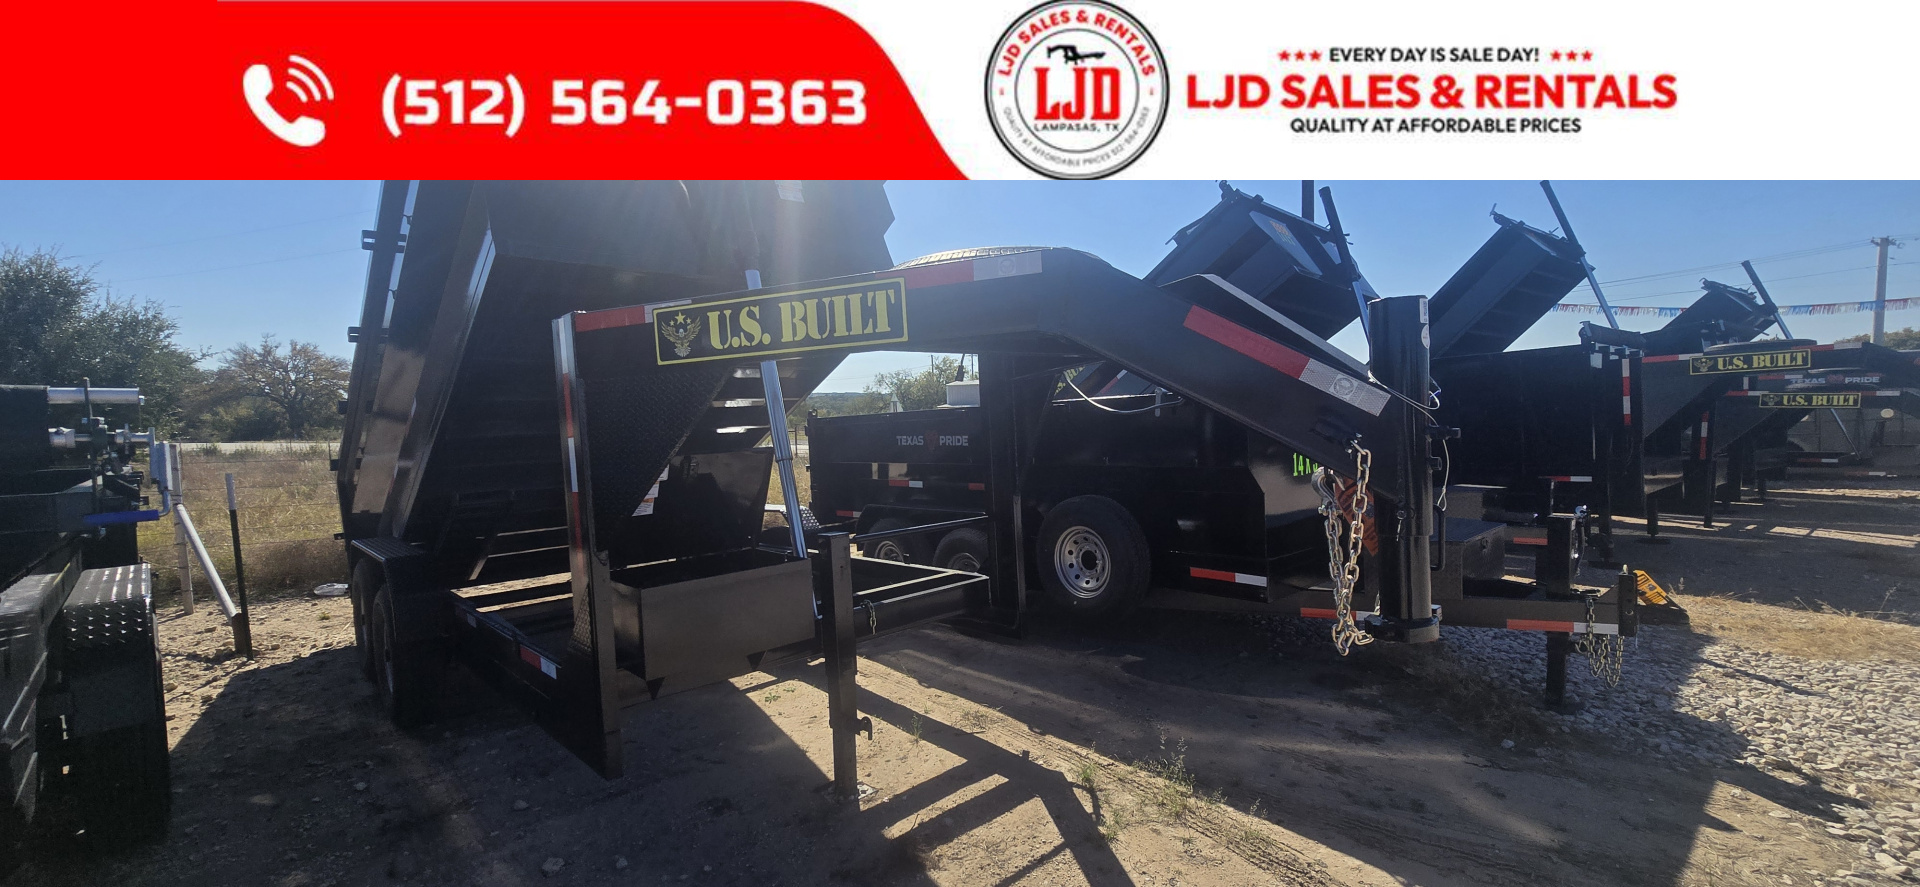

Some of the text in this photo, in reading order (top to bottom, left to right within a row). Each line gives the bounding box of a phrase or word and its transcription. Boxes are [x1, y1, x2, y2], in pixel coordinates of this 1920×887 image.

[706, 288, 895, 350] U.S. BUILT
[1717, 351, 1806, 370] U.S. BUILT
[1844, 376, 1881, 384] PRIDE
[1782, 394, 1857, 406] U.S. BUILT
[896, 435, 969, 446] TEXAS PRIDE
